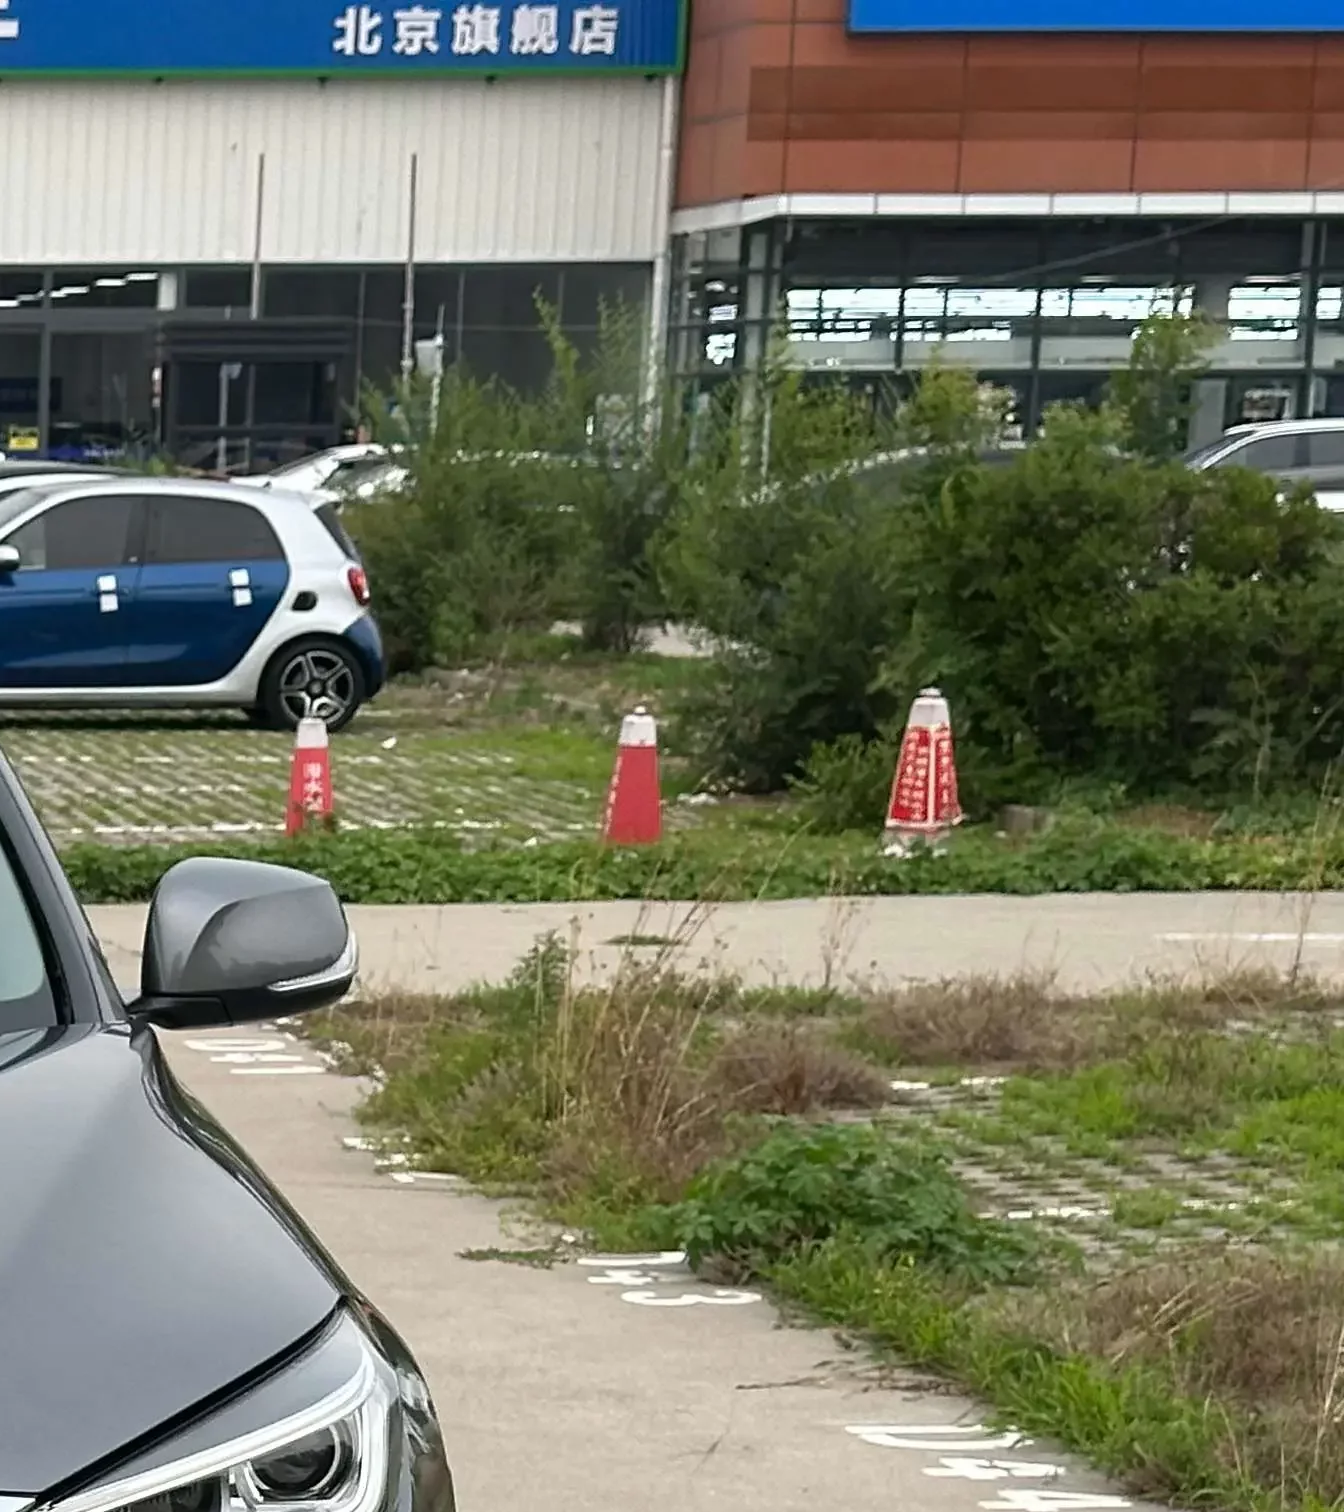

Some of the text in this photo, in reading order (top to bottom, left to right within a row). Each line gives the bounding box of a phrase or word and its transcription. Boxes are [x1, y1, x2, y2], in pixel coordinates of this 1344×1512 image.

[333, 4, 619, 56] 北京旗舰店
